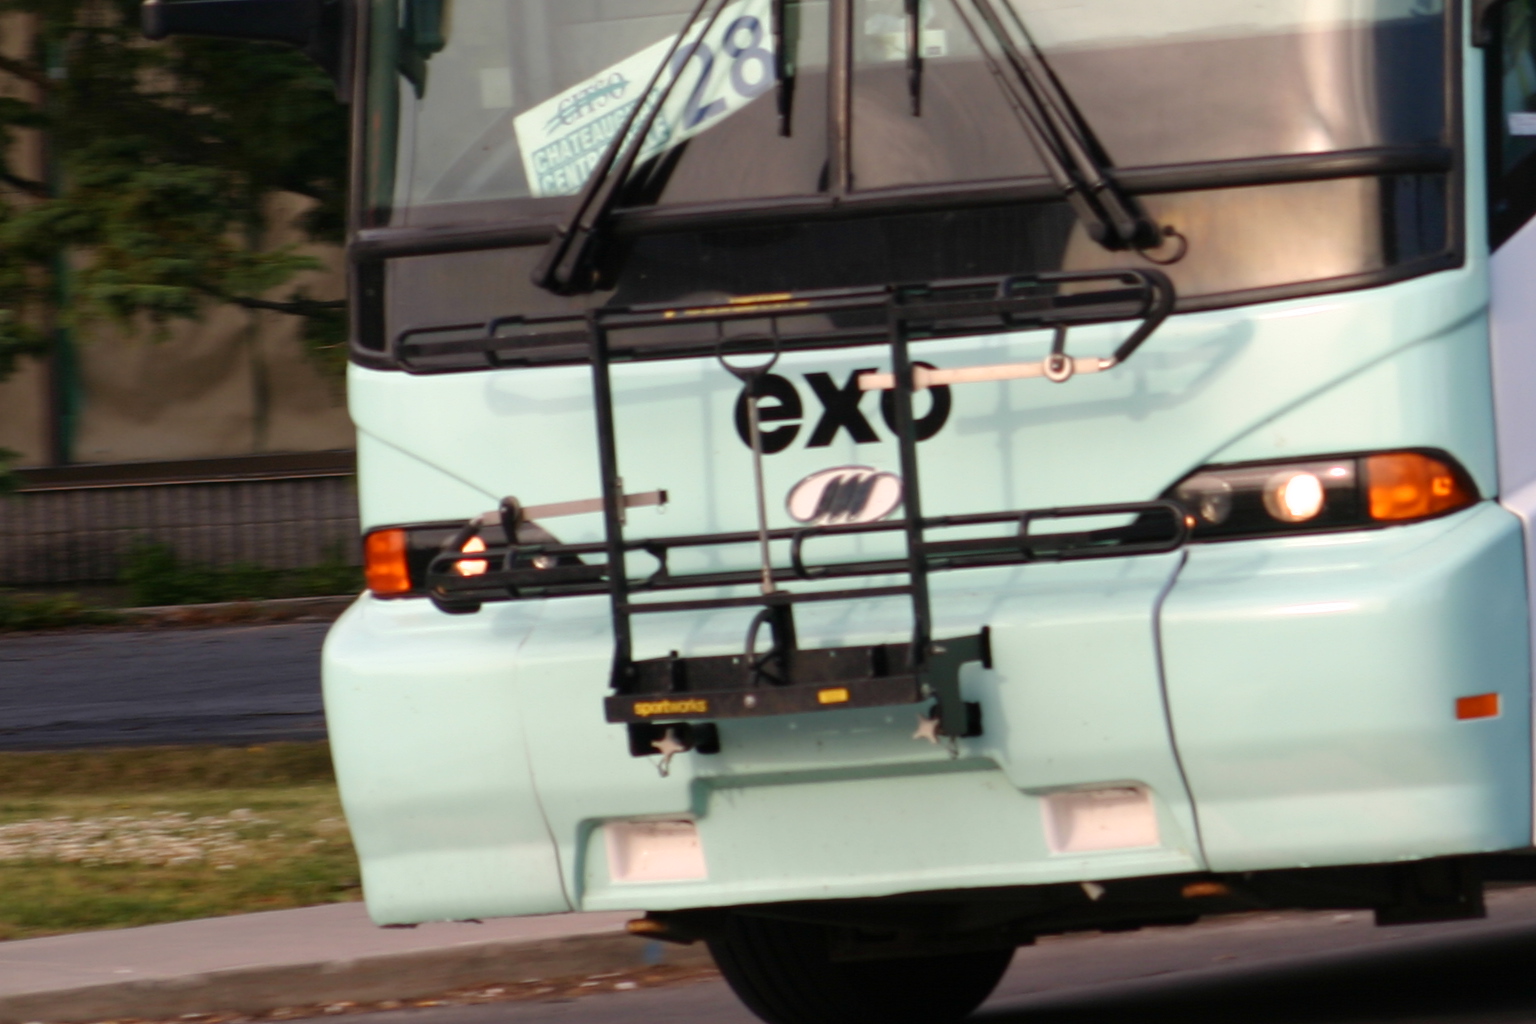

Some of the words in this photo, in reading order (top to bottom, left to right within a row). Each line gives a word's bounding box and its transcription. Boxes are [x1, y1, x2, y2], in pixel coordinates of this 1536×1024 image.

[669, 14, 777, 130] 28
[735, 360, 952, 455] exo
[633, 698, 708, 717] sportworks
